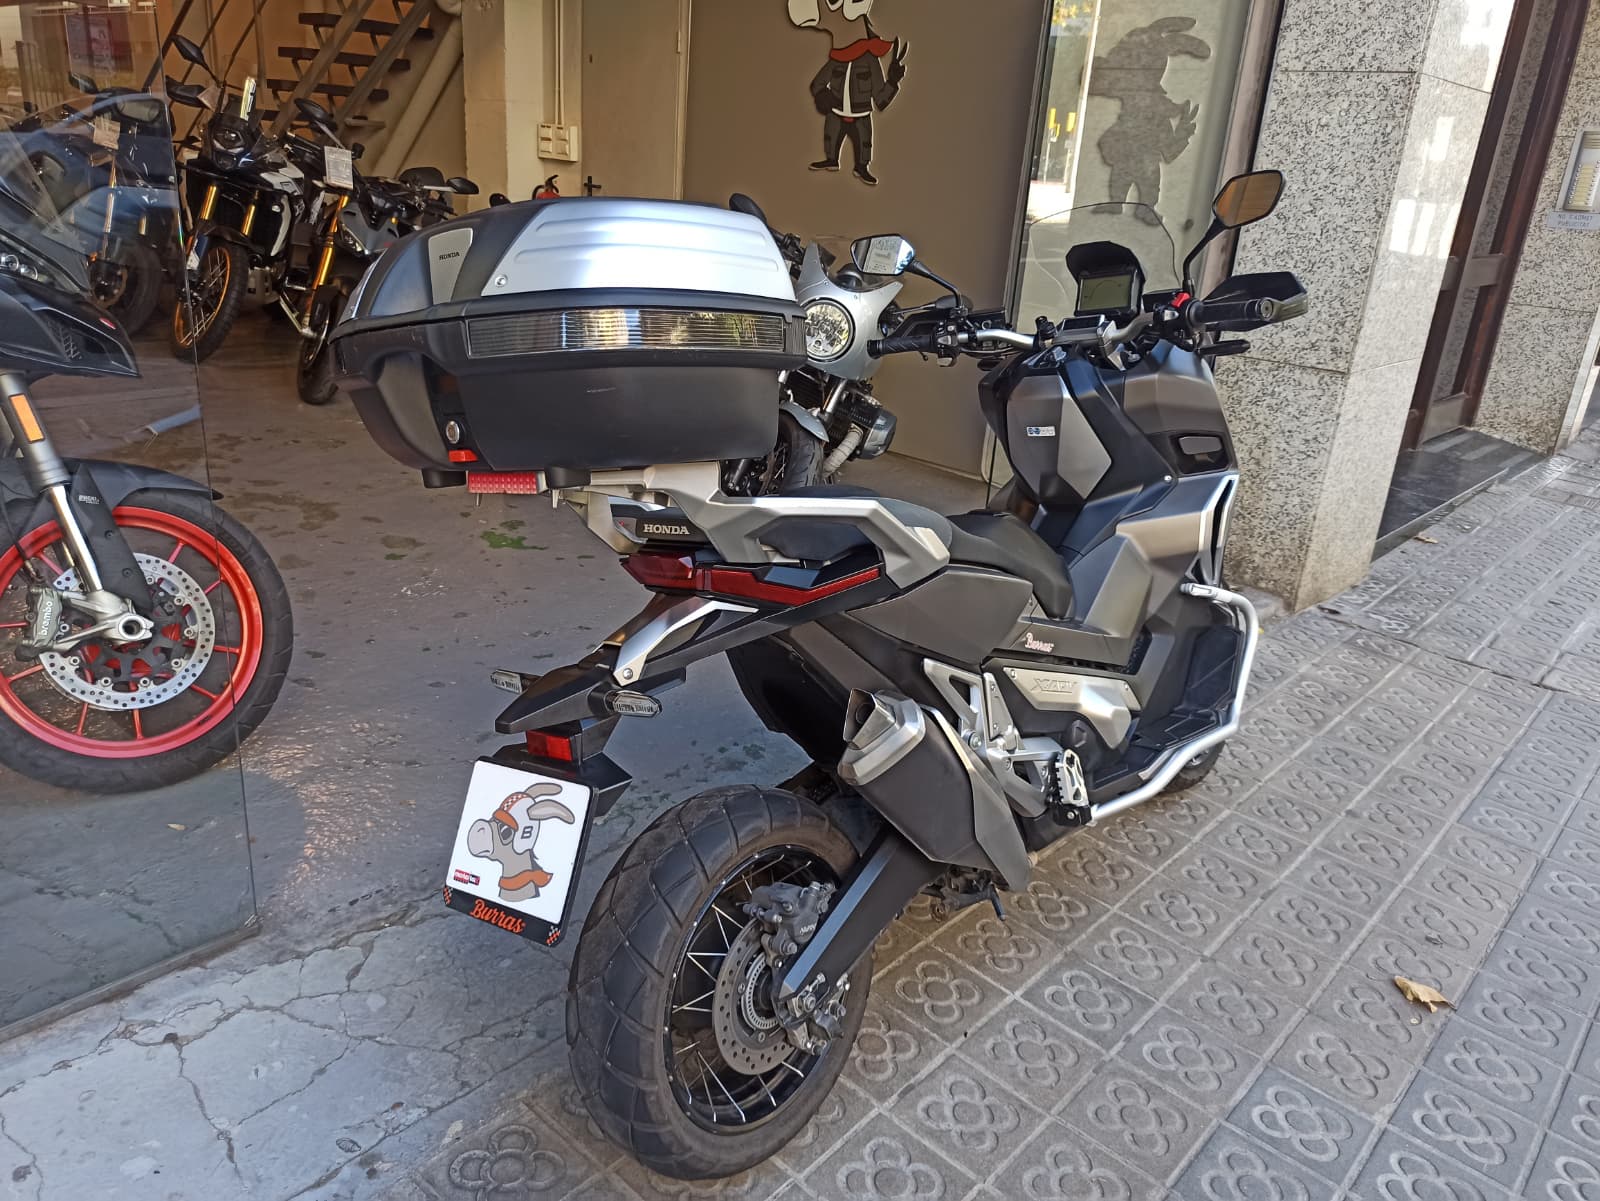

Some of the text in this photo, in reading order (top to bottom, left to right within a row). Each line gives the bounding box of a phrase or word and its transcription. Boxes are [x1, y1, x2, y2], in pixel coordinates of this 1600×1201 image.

[439, 252, 460, 260] HONDA
[644, 523, 690, 535] HONDA
[40, 601, 53, 635] brembo
[520, 825, 533, 839] B
[470, 899, 526, 933] Burras
